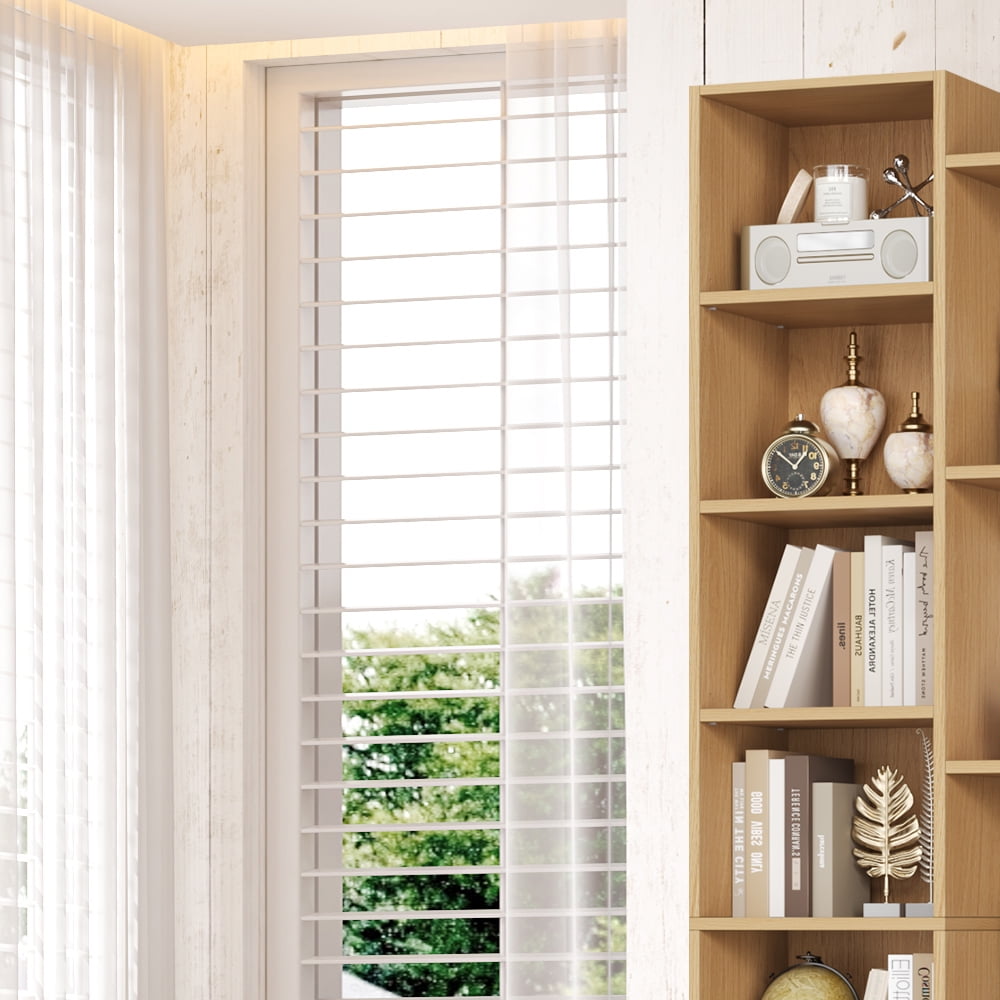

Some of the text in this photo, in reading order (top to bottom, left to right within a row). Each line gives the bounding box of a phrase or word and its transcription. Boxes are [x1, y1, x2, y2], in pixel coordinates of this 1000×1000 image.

[764, 573, 803, 680] MERINGUES MACARONS
[786, 643, 798, 660] THE
